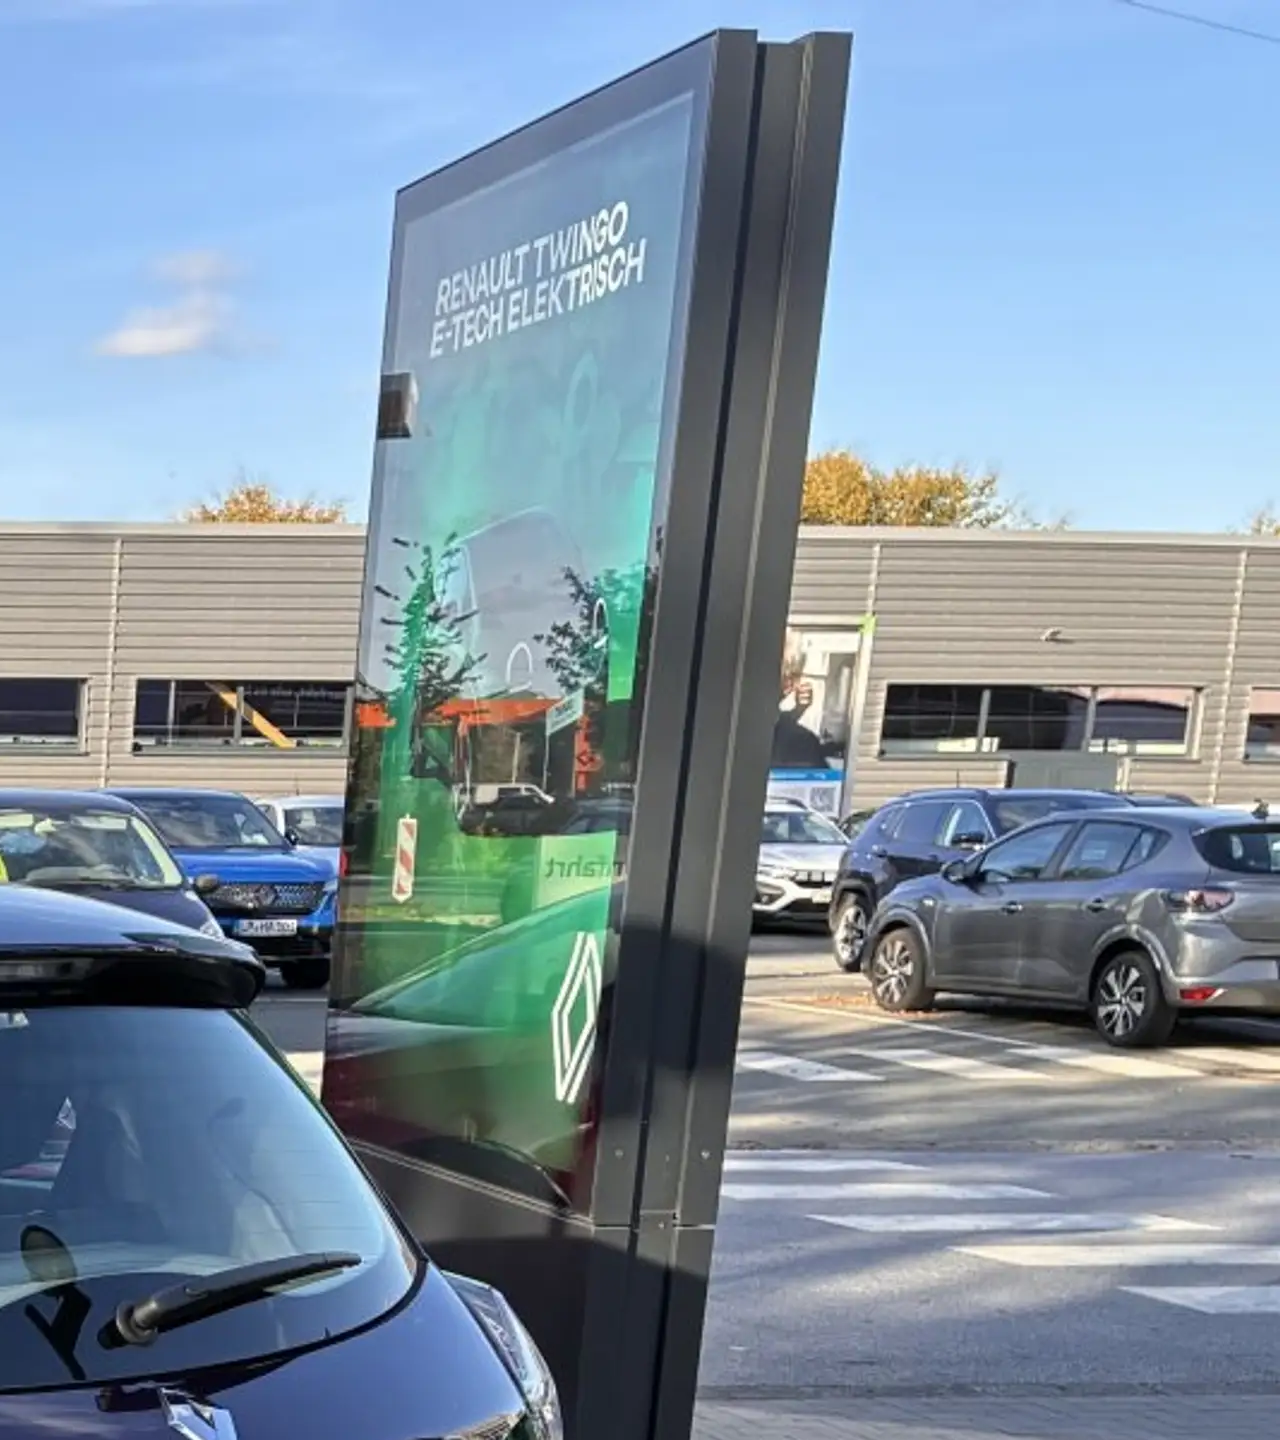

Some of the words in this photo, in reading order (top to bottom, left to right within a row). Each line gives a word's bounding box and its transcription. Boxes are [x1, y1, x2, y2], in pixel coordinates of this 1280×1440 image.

[430, 294, 505, 359] E-TECH
[507, 238, 648, 333] ELEKTRISCH
[435, 243, 530, 316] RENAULT
[533, 201, 628, 278] TWINGO
